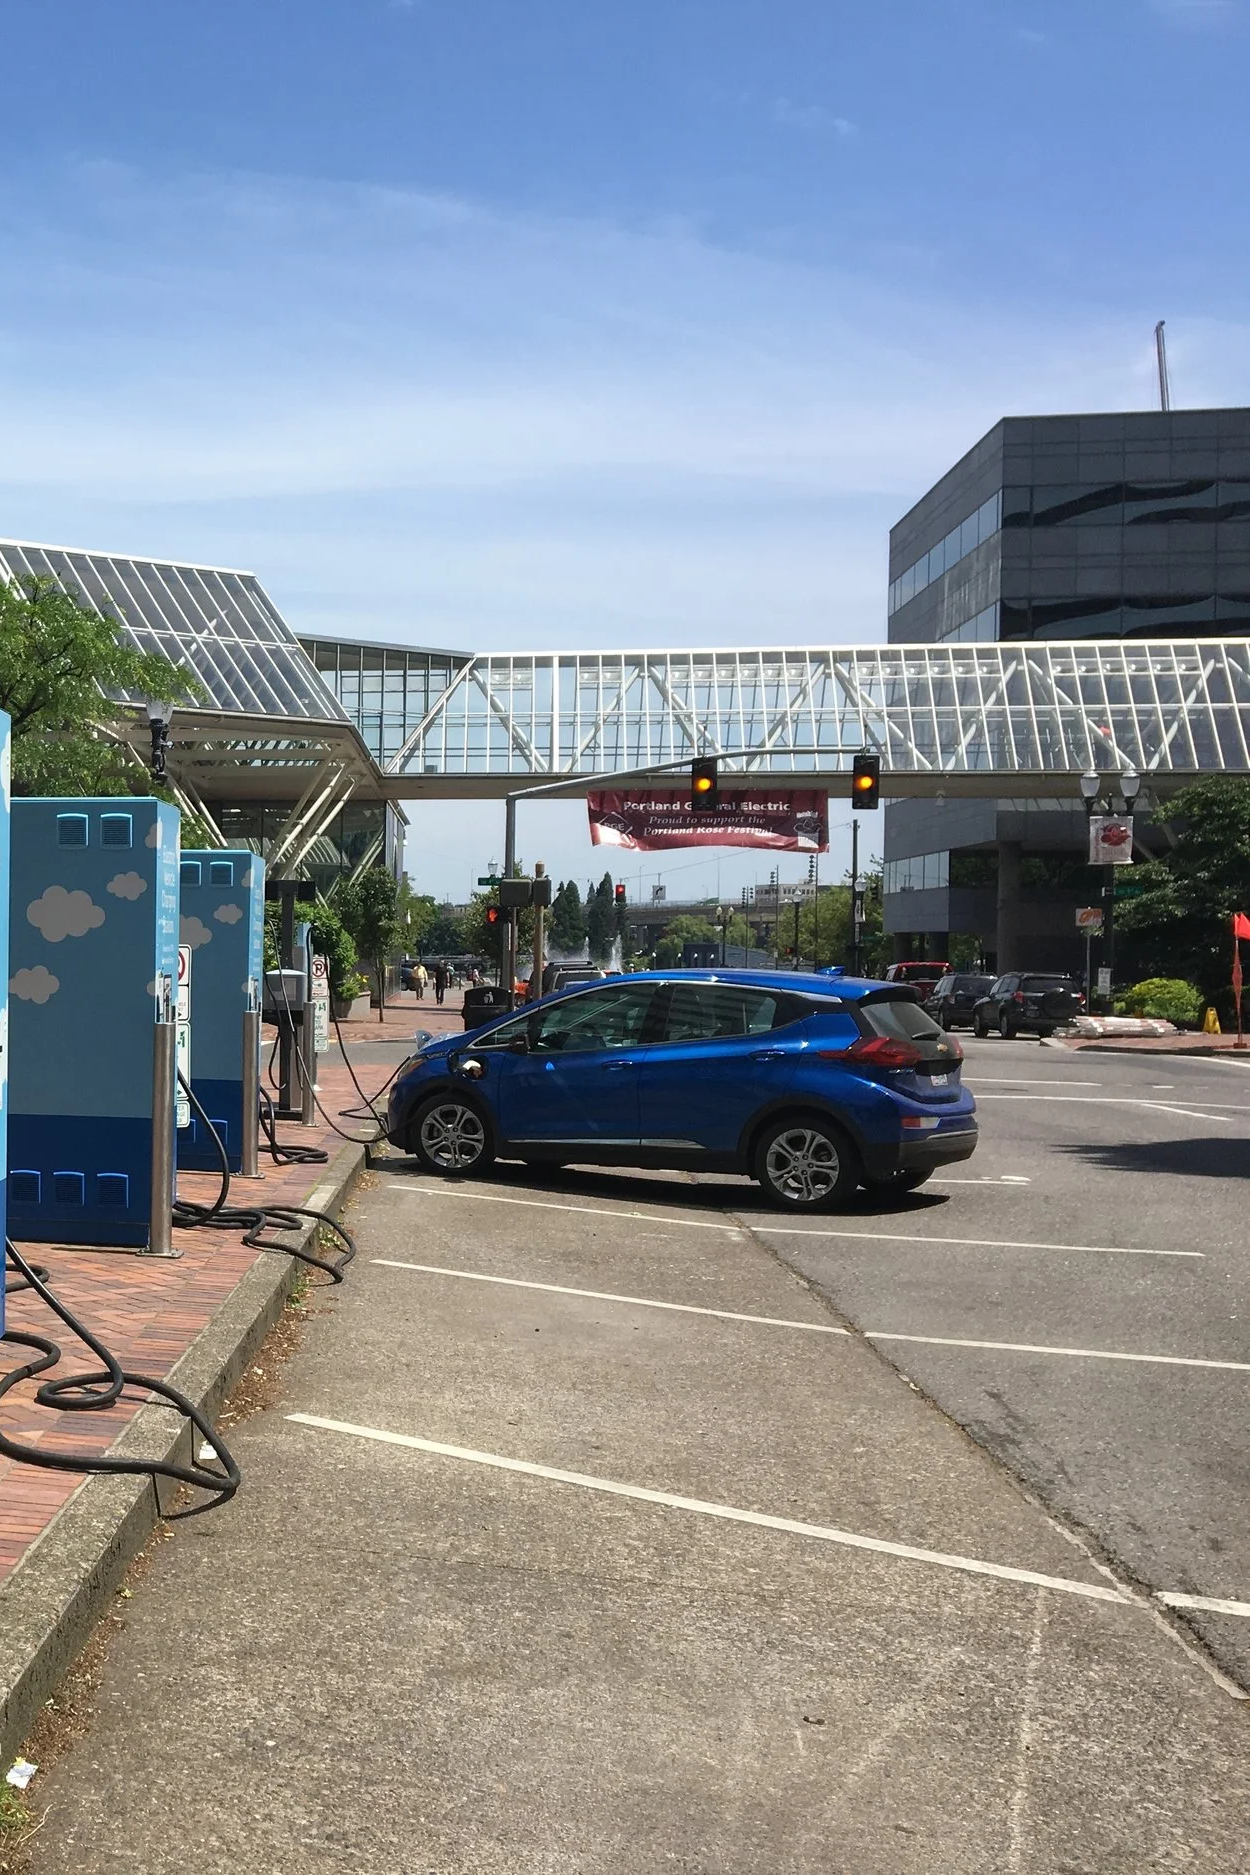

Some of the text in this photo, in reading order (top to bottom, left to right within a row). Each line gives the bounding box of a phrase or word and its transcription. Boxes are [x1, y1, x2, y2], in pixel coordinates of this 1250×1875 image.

[623, 801, 790, 812] Portland Gral Electric
[649, 815, 766, 825] Proud to support the
